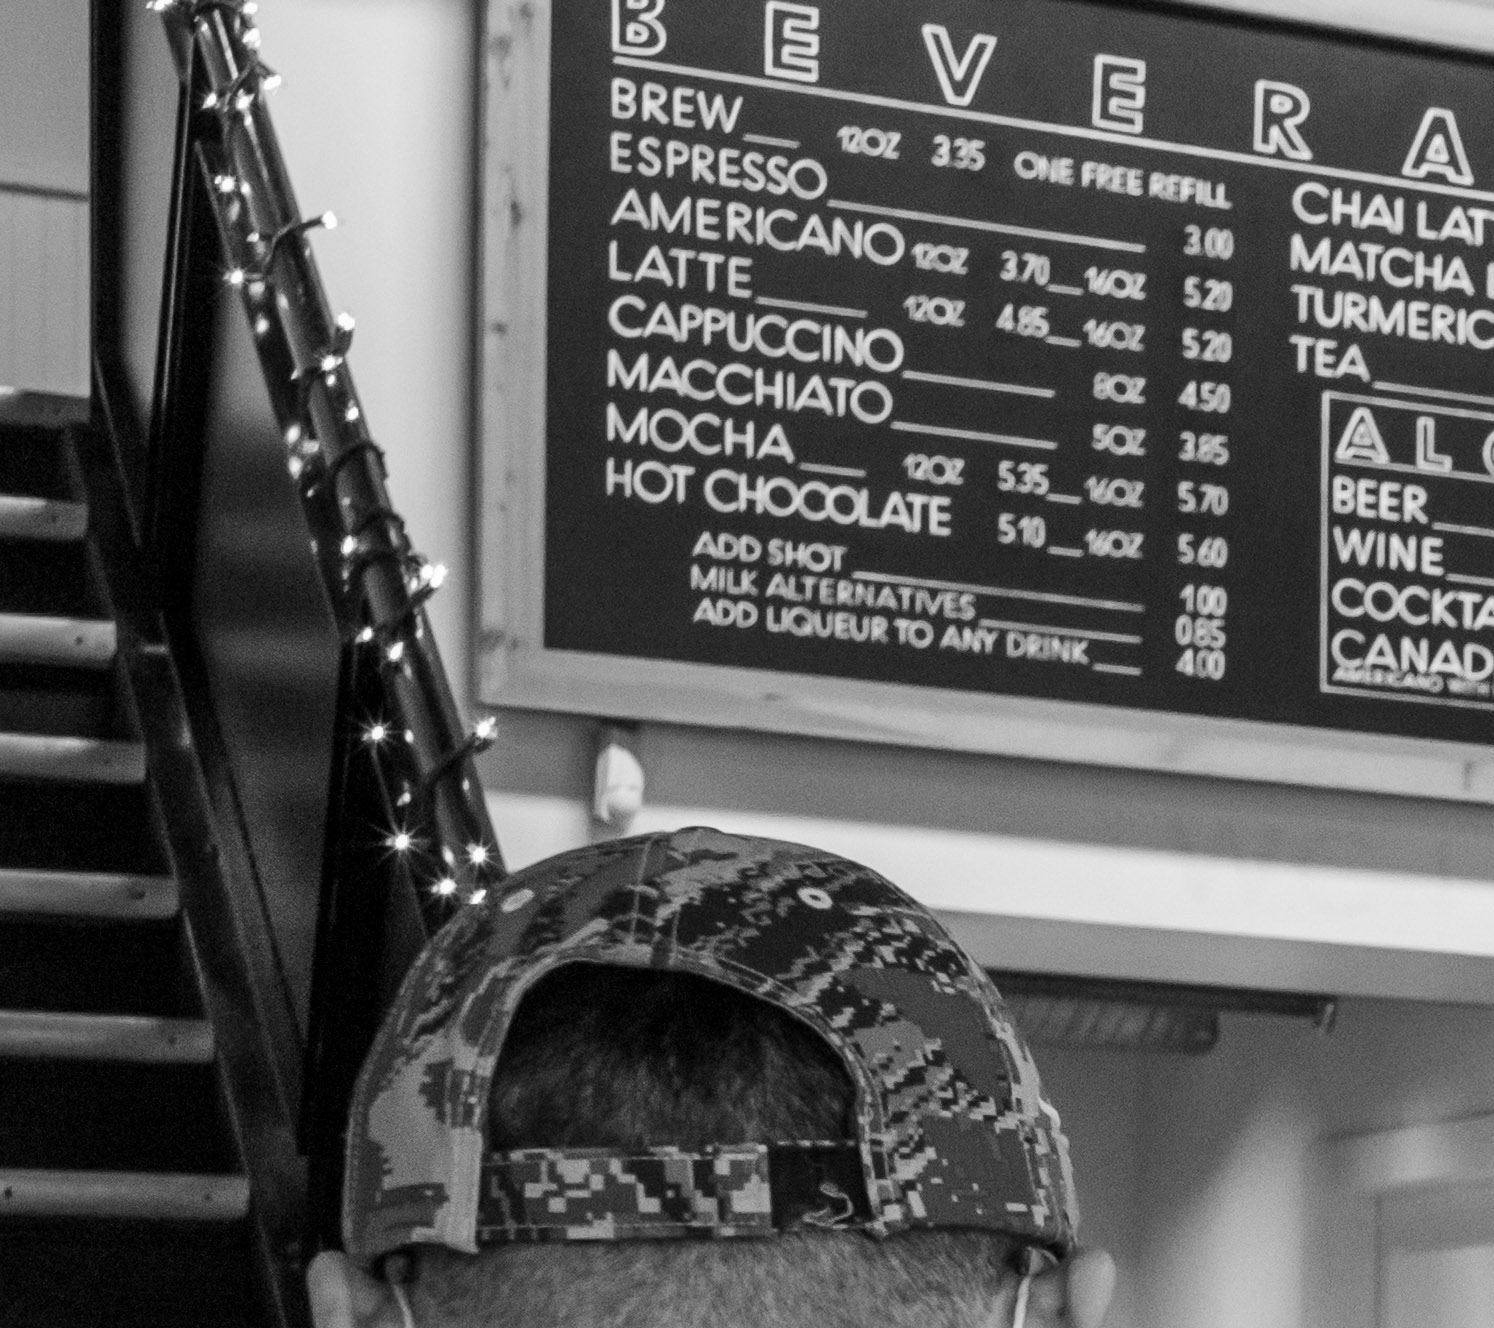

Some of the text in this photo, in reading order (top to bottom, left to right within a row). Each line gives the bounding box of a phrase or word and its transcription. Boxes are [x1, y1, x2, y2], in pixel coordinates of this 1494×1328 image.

[609, 132, 827, 200] ESPRESSO
[610, 77, 743, 133] BREW
[837, 126, 900, 159] 12OZ
[1013, 151, 1073, 184] ONE
[1081, 161, 1142, 196] FREE
[1148, 169, 1232, 209] REFILL
[611, 188, 903, 265] AMERICANO
[1291, 181, 1403, 230] CHAI
[608, 241, 752, 298] LATTE
[1290, 234, 1474, 295] MATCHA
[607, 295, 903, 373] CAPPUCCINO
[1290, 334, 1371, 383] TEA
[607, 349, 892, 423] MACCHIATO
[606, 402, 795, 464] MOCHA
[605, 457, 695, 503] HOT
[703, 467, 951, 536] CHOCOLATE
[1332, 475, 1430, 524] BEER
[692, 531, 761, 563] ADD
[766, 537, 847, 572] SHOT
[1332, 526, 1444, 576] WINE
[689, 564, 758, 596] MILK
[765, 573, 977, 621] ALTERNATIVES
[692, 596, 757, 628] ADD
[766, 605, 889, 644] LIQUEUR
[894, 617, 934, 648] TO
[939, 622, 999, 655] ANY
[1006, 630, 1090, 665] DRINK
